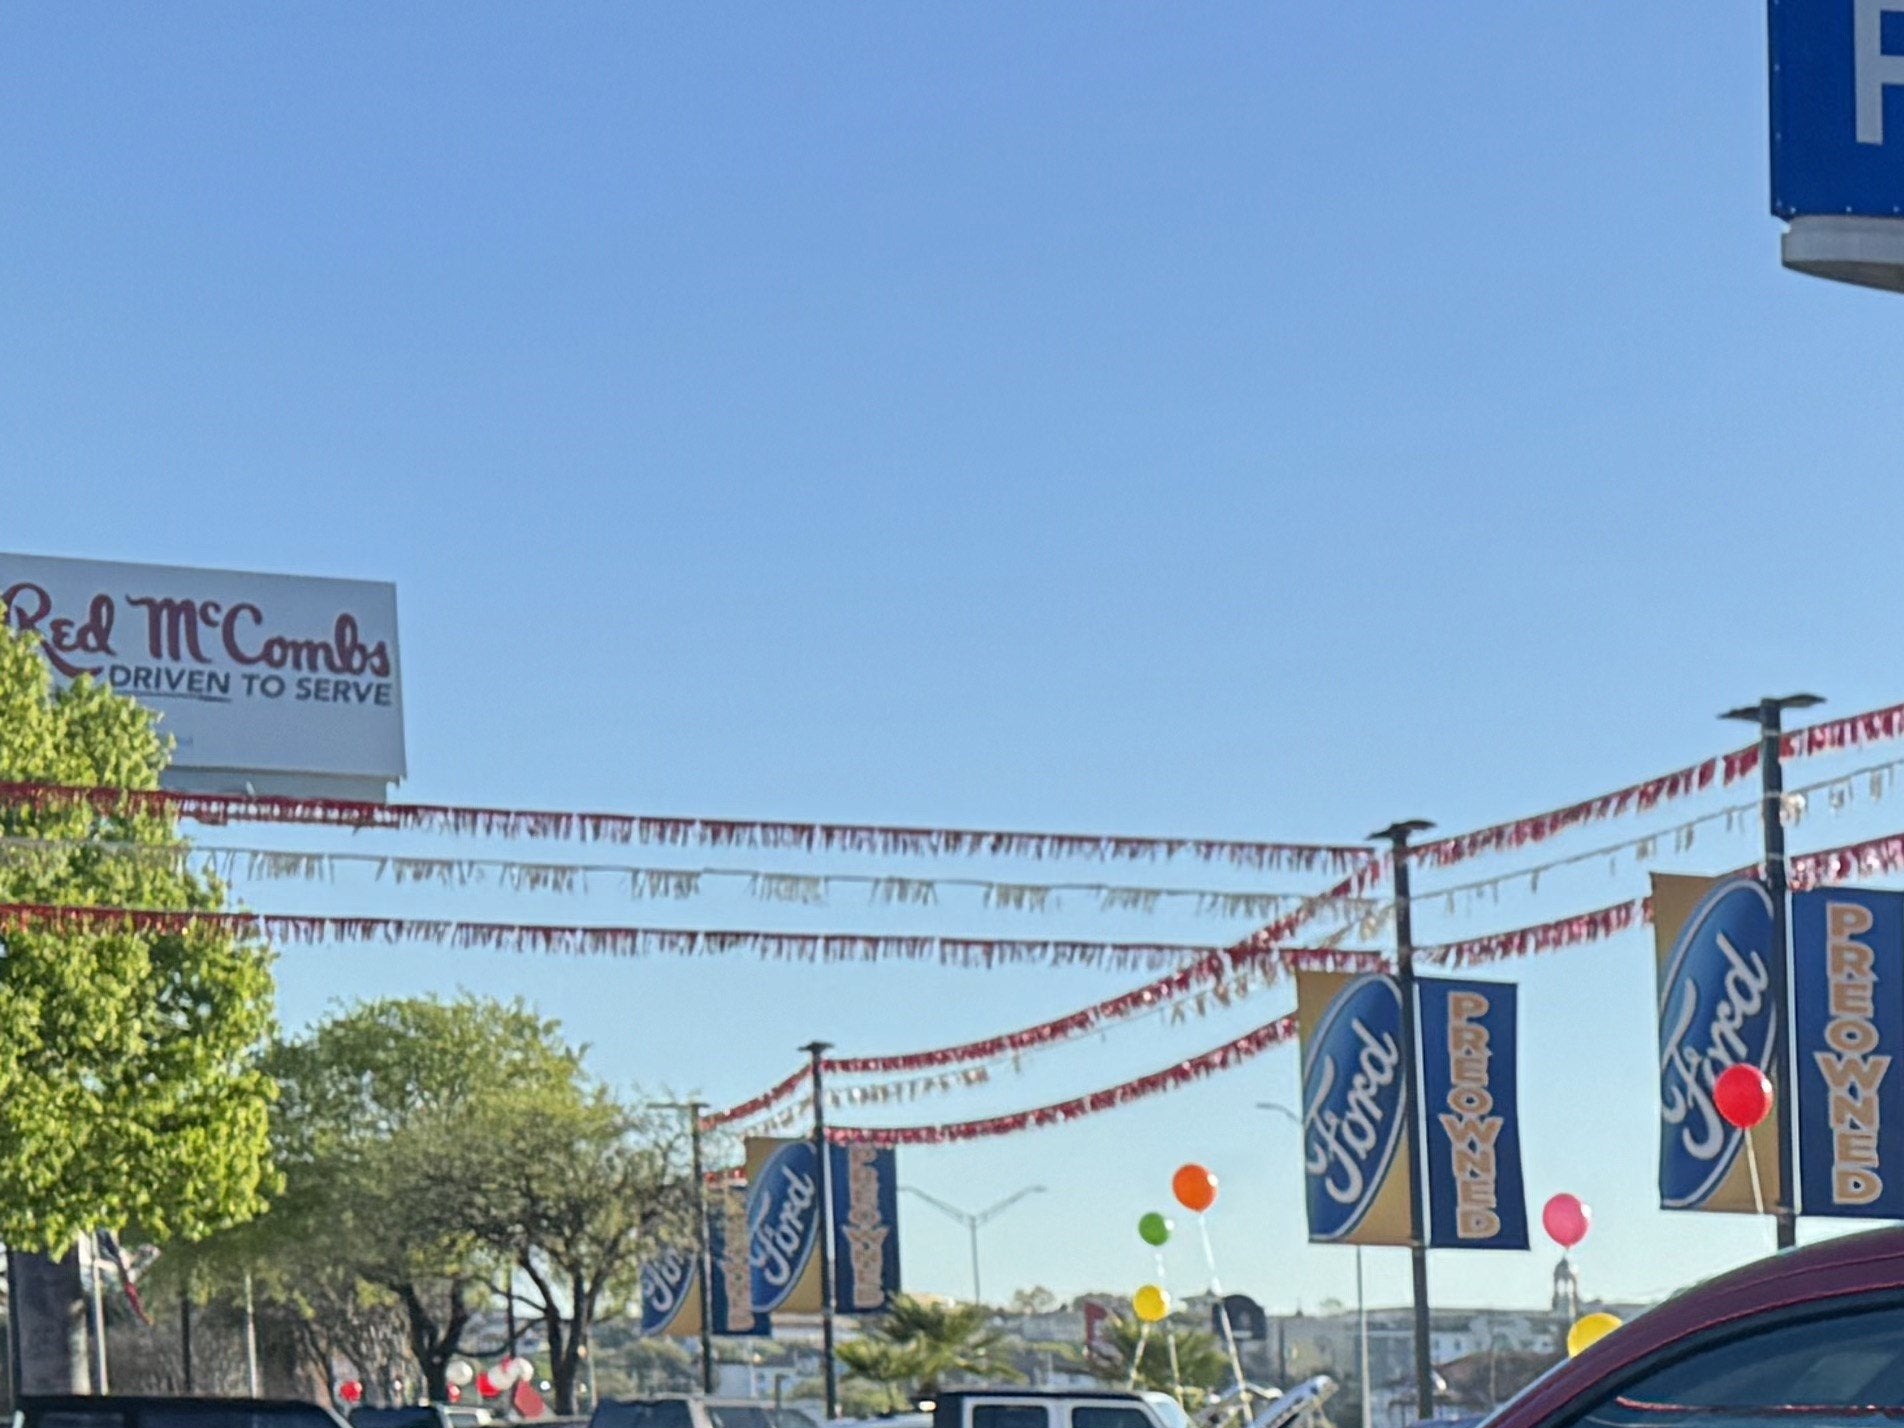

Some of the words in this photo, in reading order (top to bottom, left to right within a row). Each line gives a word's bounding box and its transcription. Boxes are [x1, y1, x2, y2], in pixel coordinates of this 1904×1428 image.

[3, 582, 116, 678] Red
[125, 593, 392, 679] McCombs
[110, 663, 231, 695] DRIVEN
[241, 673, 285, 699] TO
[295, 677, 392, 706] SERVE
[1302, 1018, 1400, 1205] Ford
[1438, 990, 1503, 1240] PREOWNED
[1812, 901, 1893, 1205] PREOWNED
[750, 1164, 816, 1286] Ford
